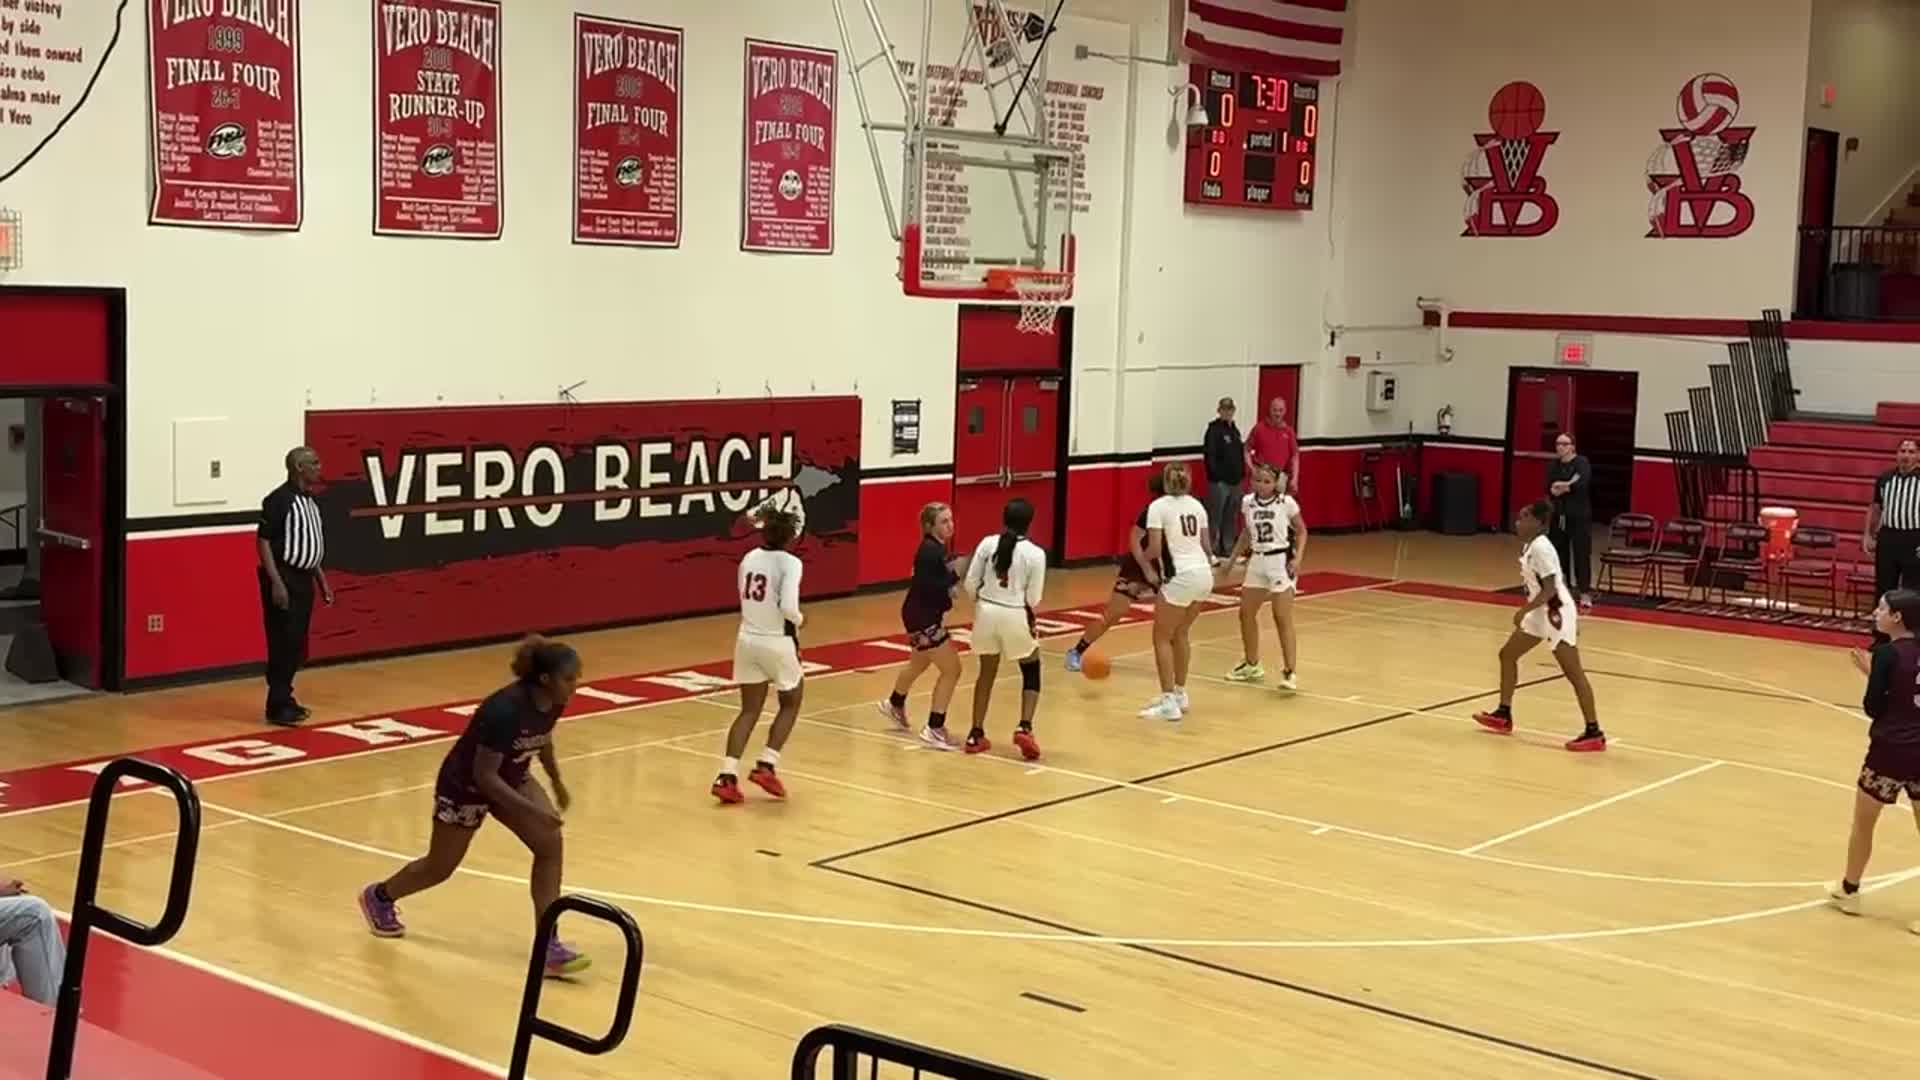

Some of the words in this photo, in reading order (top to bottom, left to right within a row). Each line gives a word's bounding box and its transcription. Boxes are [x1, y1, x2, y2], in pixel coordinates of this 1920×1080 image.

[1, 16, 15, 36] by
[382, 3, 431, 56] VERO
[435, 8, 494, 71] BEACH
[15, 40, 41, 58] them
[582, 31, 624, 80] VERO
[626, 35, 676, 93] BEACH
[21, 66, 45, 82] echo
[165, 57, 225, 90] FINAL
[232, 62, 281, 100] FOUR
[417, 69, 461, 96] STATE
[751, 55, 787, 100] VERO
[790, 58, 832, 110] BEACH
[1, 84, 26, 103] alma
[31, 91, 61, 105] mater
[1251, 75, 1289, 112] 7:30
[8, 109, 33, 125] Vero
[389, 93, 485, 128] RUNNER-UP
[586, 102, 630, 130] FINAL
[634, 105, 669, 139] FOUR
[1221, 93, 1234, 128] 0
[1304, 105, 1317, 138] 0
[753, 120, 793, 148] FINAL
[795, 123, 826, 152] FOUR
[1283, 131, 1288, 153] 1
[1210, 152, 1221, 177] 0
[1300, 161, 1310, 185] 0
[366, 446, 565, 539] VERO
[595, 436, 793, 522] BEACH
[1179, 513, 1198, 537] 10
[1255, 521, 1274, 543] 12
[743, 571, 767, 602] 13
